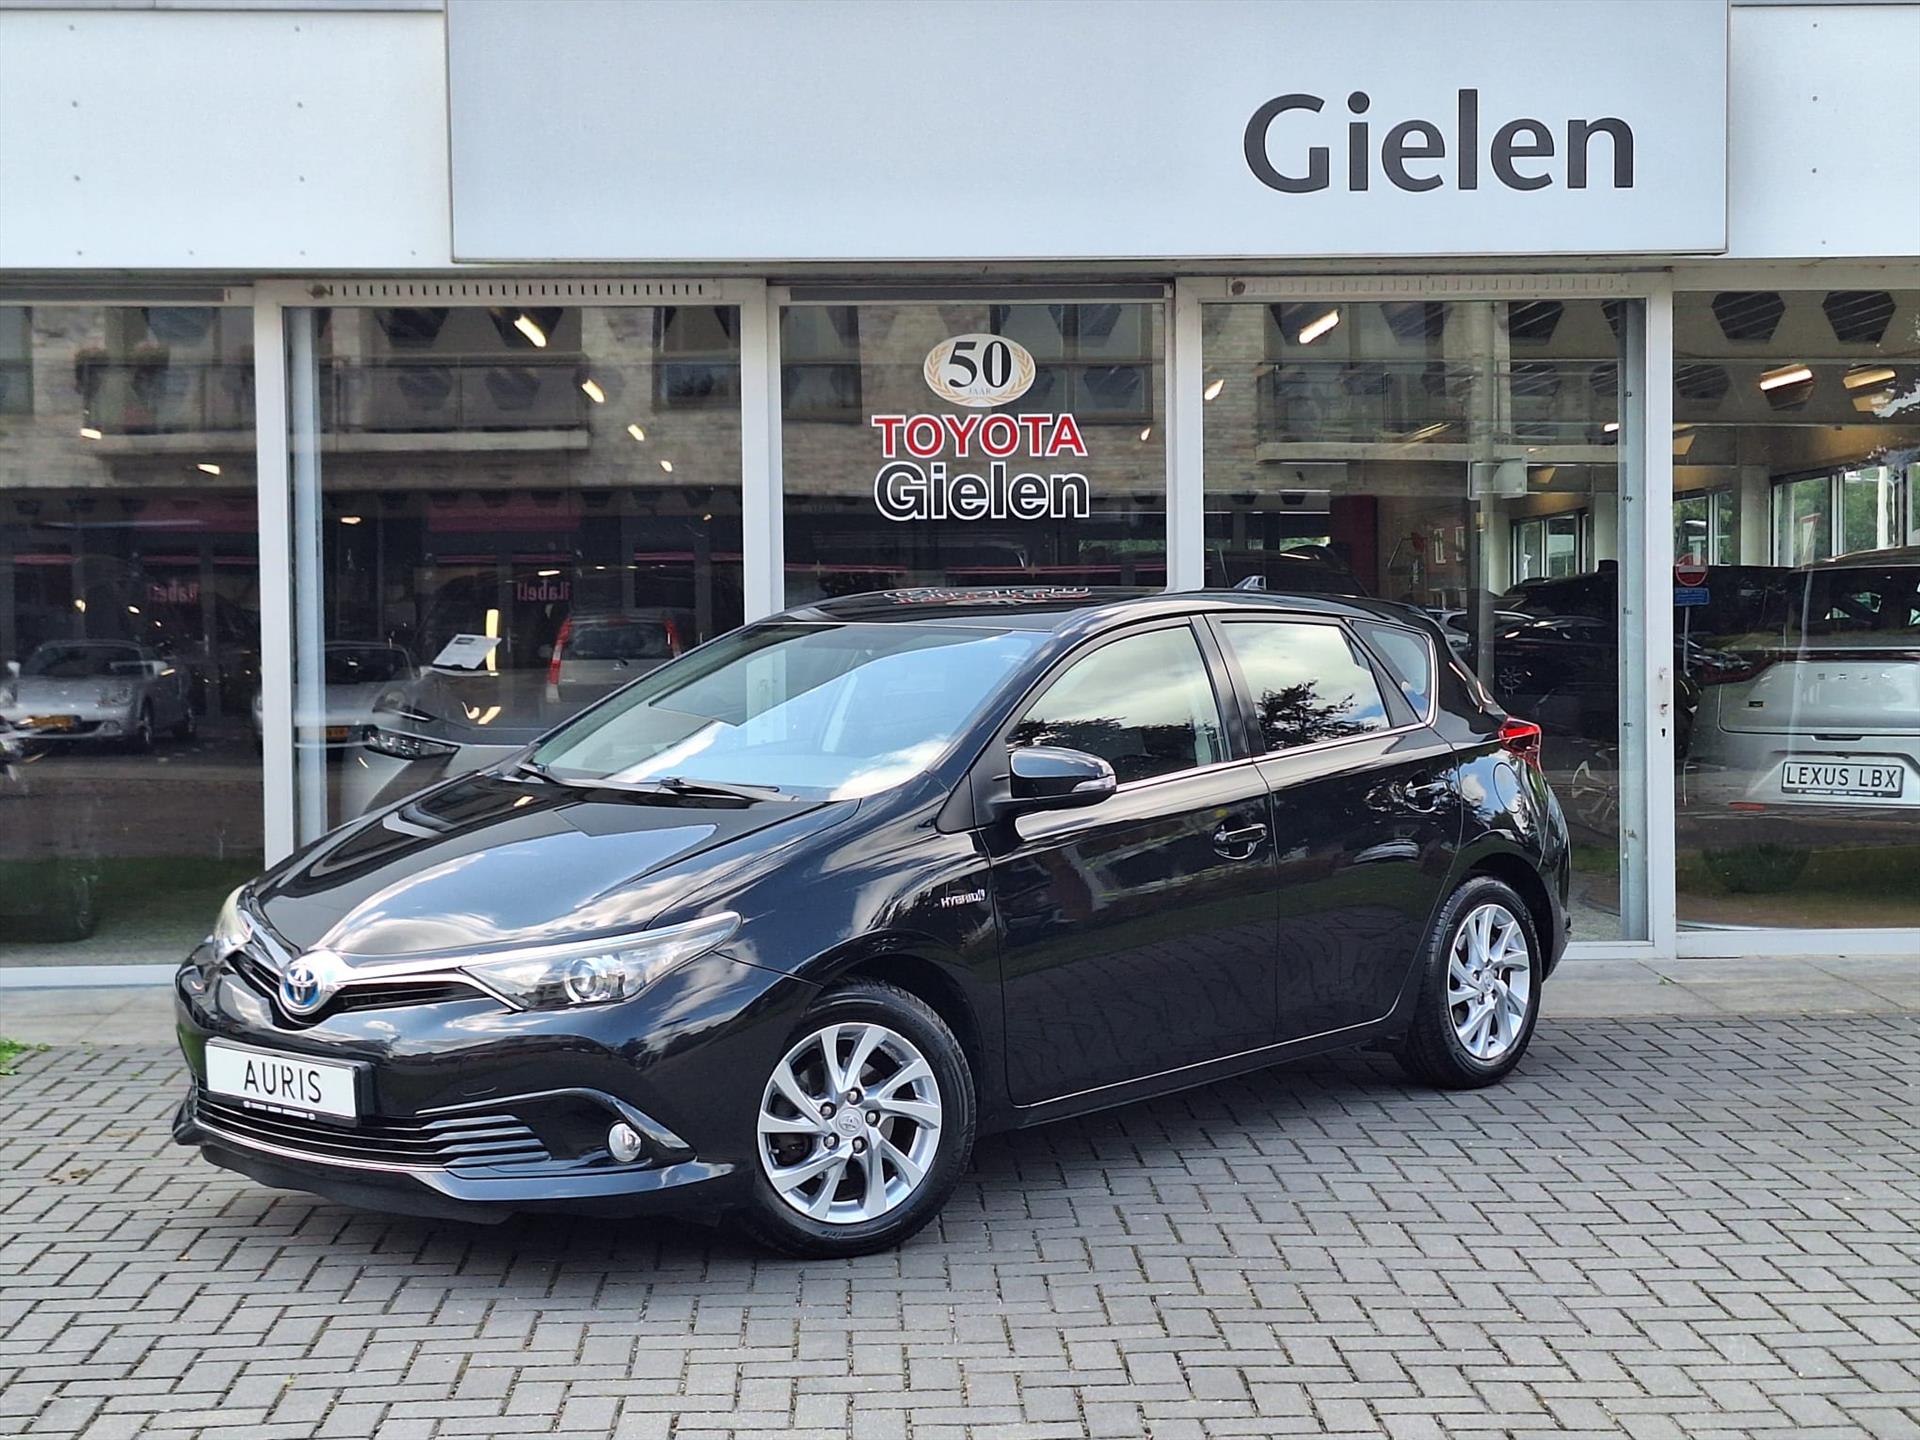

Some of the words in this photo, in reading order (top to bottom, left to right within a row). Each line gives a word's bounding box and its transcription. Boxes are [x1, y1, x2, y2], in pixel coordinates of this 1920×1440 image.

[1243, 88, 1635, 194] Gielen
[948, 340, 1012, 388] 50
[871, 413, 1089, 458] TOYOTA
[874, 460, 1090, 521] Gielen
[1786, 766, 1849, 786] LEXUS
[1858, 768, 1897, 788] LBX
[244, 1059, 322, 1104] AURIS
